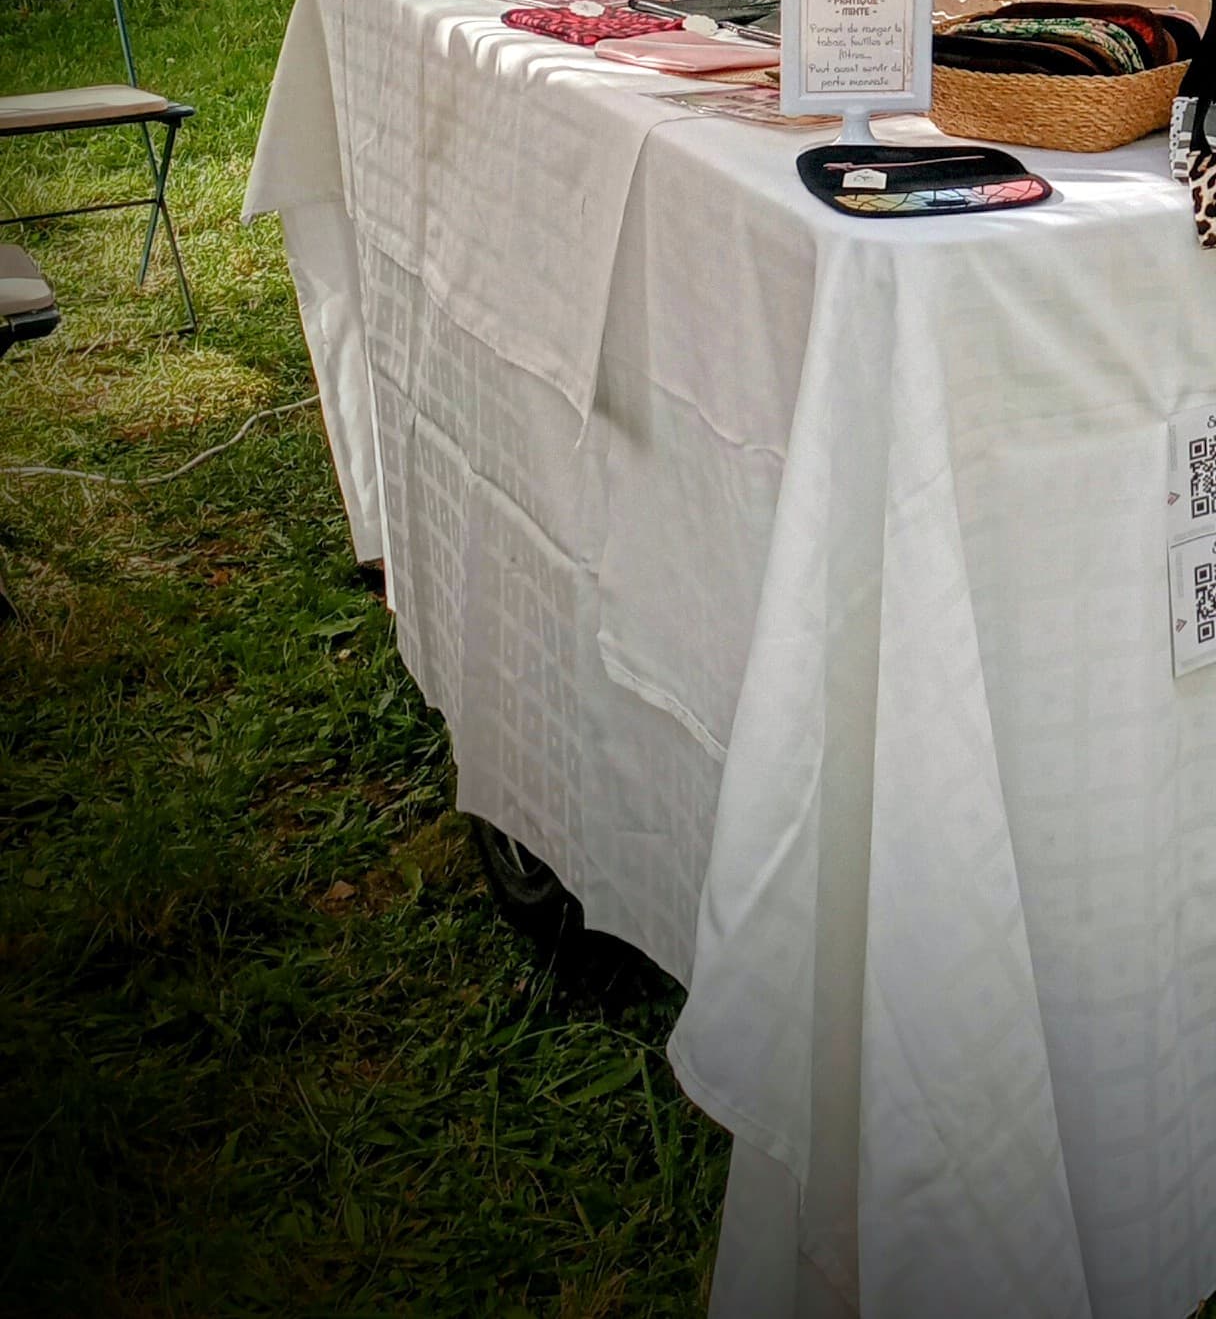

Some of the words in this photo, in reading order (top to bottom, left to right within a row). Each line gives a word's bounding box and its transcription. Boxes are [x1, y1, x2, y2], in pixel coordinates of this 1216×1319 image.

[841, 7, 870, 16] MIXTE
[809, 23, 843, 34] Permet
[847, 23, 858, 33] de
[862, 25, 891, 37] ranger
[850, 35, 881, 47] feuilles
[885, 34, 894, 46] et
[808, 61, 830, 73] Peut
[834, 64, 858, 73] aussi
[862, 63, 889, 72] servir
[821, 75, 846, 90] porte
[849, 76, 889, 86] monnaie
